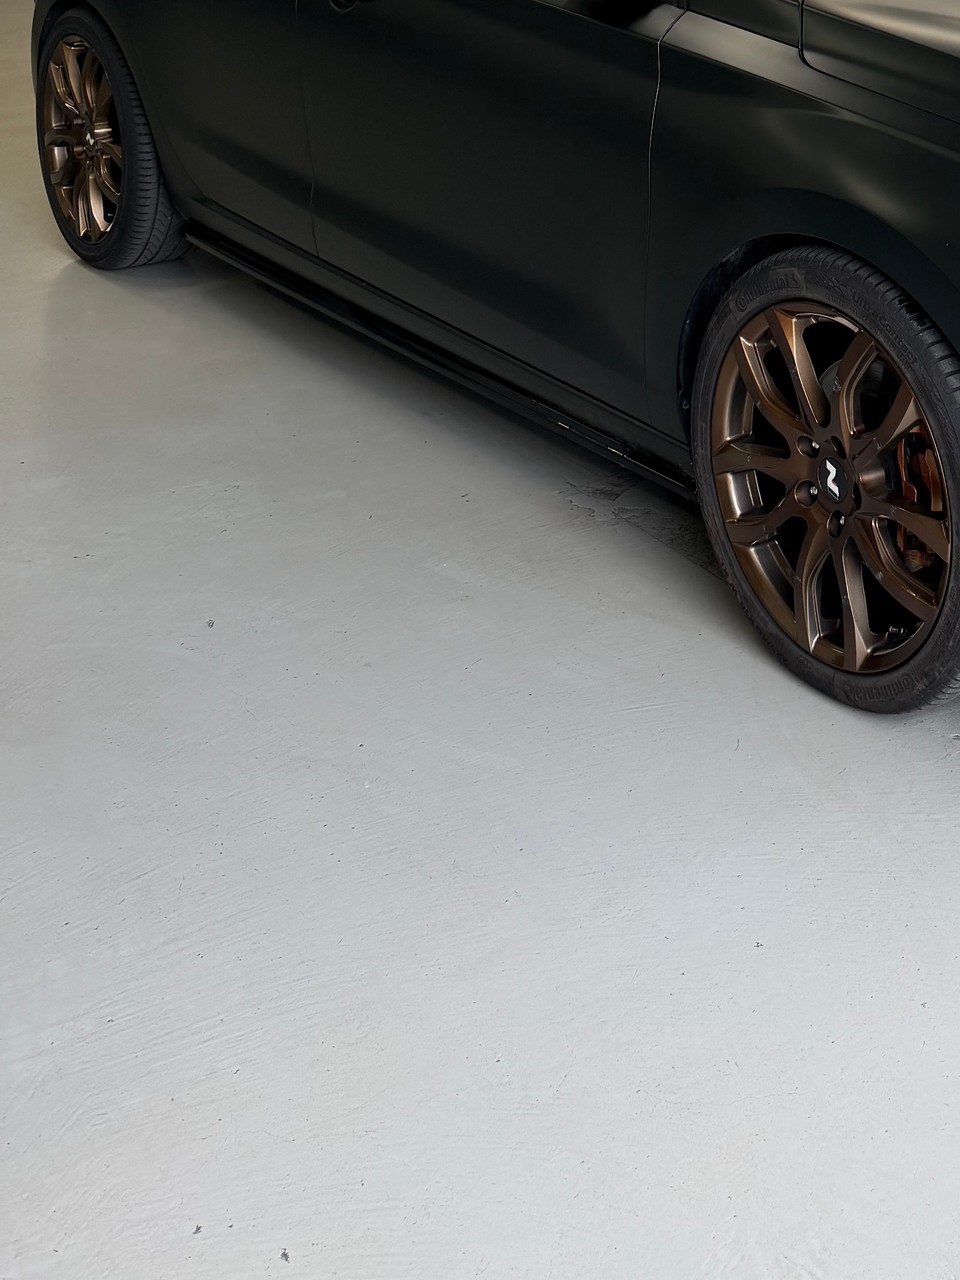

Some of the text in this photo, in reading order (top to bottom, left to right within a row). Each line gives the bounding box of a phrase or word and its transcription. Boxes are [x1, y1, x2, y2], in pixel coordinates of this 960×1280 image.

[735, 275, 790, 314] Continental
[826, 459, 840, 500] N
[850, 671, 917, 702] Continental
